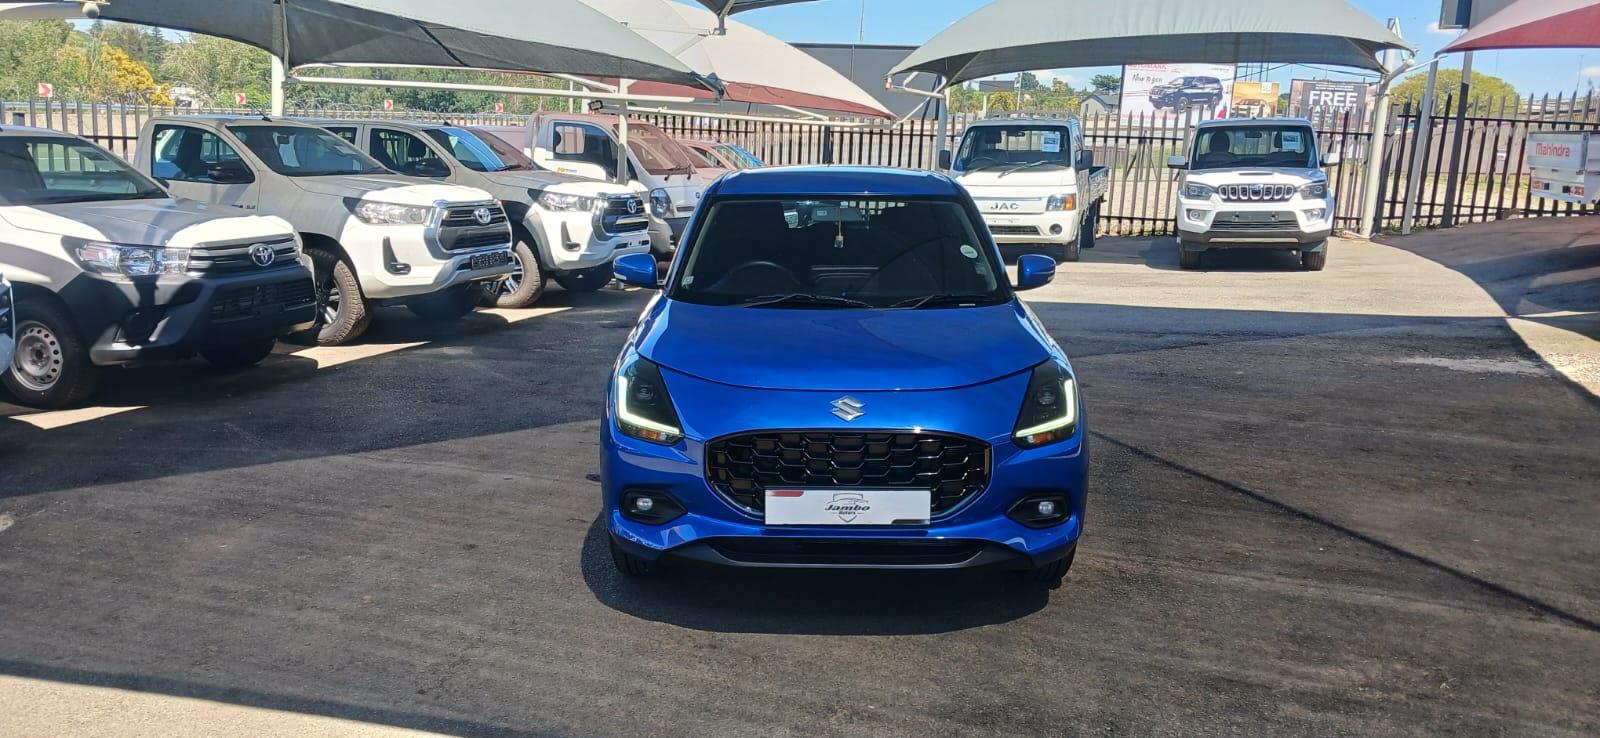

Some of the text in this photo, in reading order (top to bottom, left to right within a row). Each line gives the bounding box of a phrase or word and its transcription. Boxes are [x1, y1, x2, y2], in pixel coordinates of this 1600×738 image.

[1309, 90, 1358, 107] FREE
[1536, 142, 1570, 157] Mahindra
[990, 202, 1020, 210] JAC
